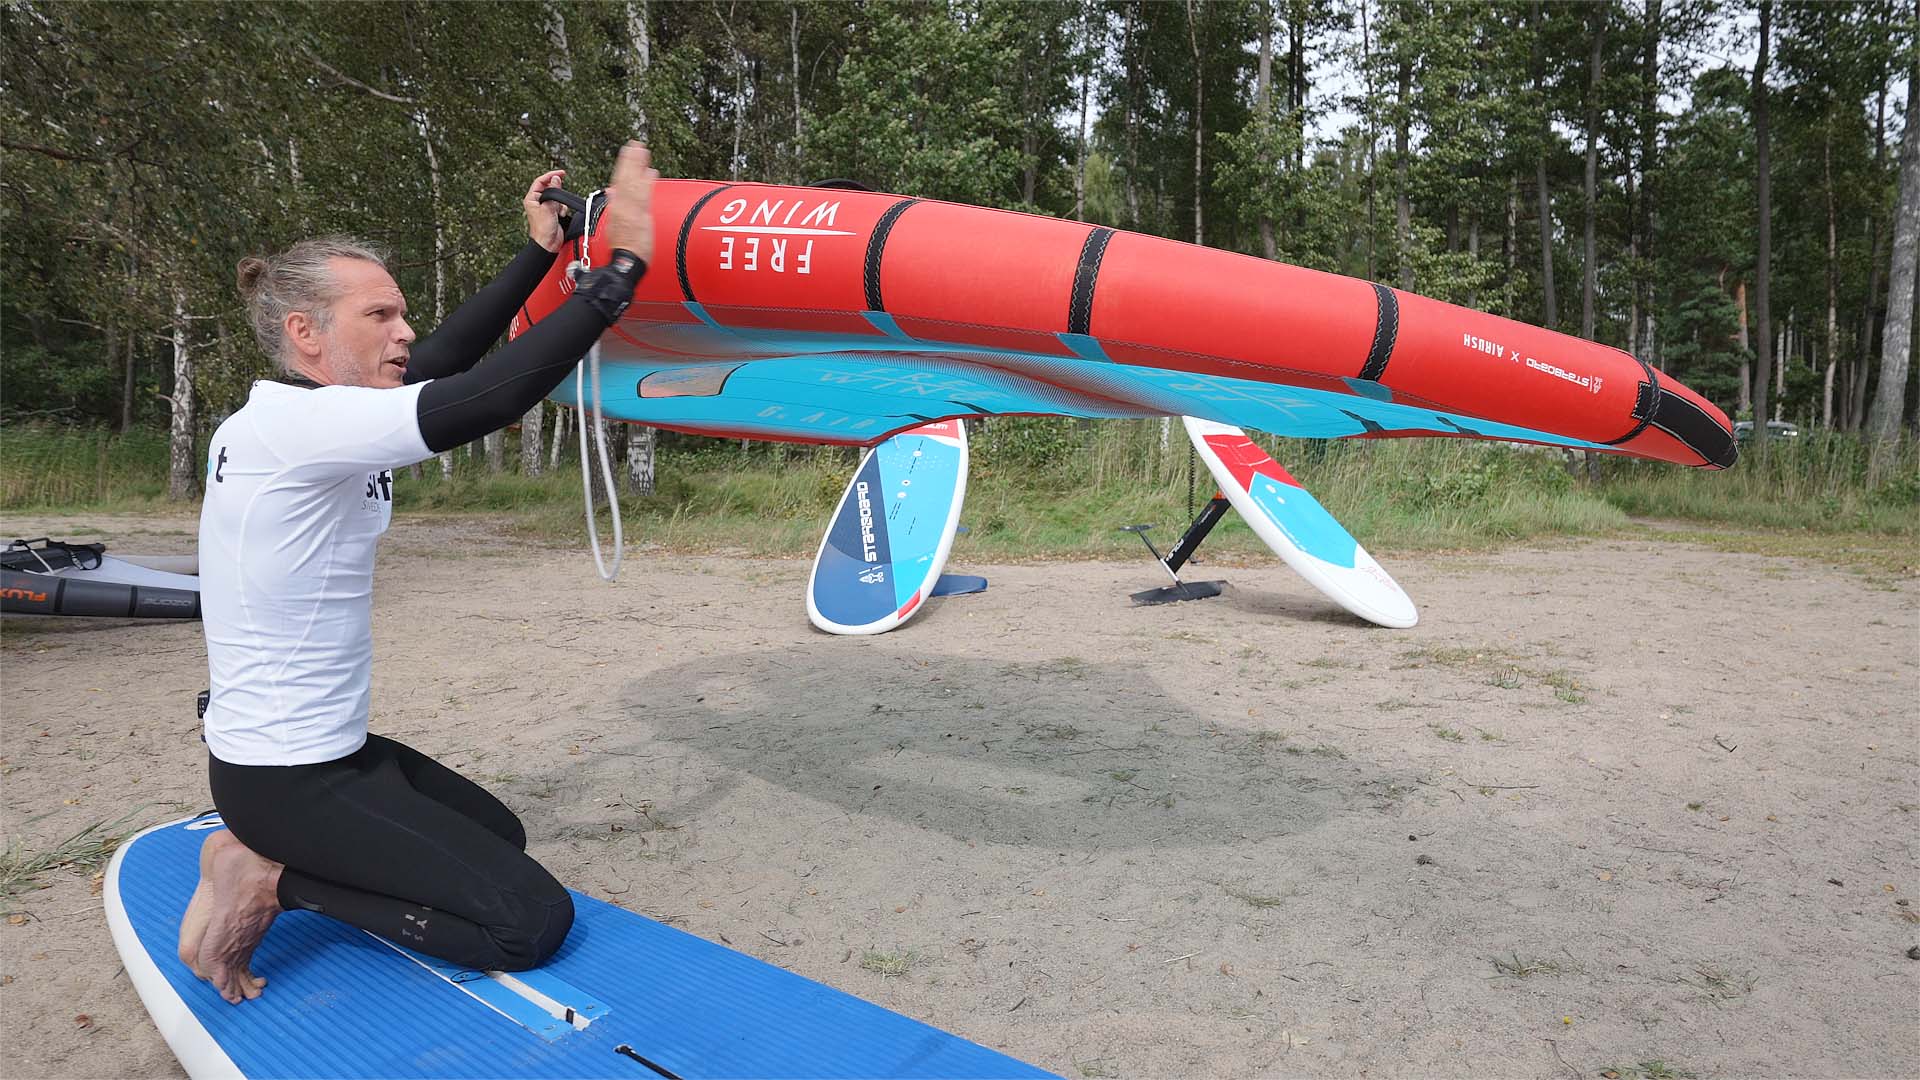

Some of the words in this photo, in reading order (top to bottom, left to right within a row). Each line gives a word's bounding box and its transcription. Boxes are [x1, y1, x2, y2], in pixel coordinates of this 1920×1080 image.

[719, 198, 841, 227] WING
[719, 236, 814, 274] FREE
[1463, 333, 1504, 358] AIRUSH
[856, 481, 878, 563] STARBOARD
